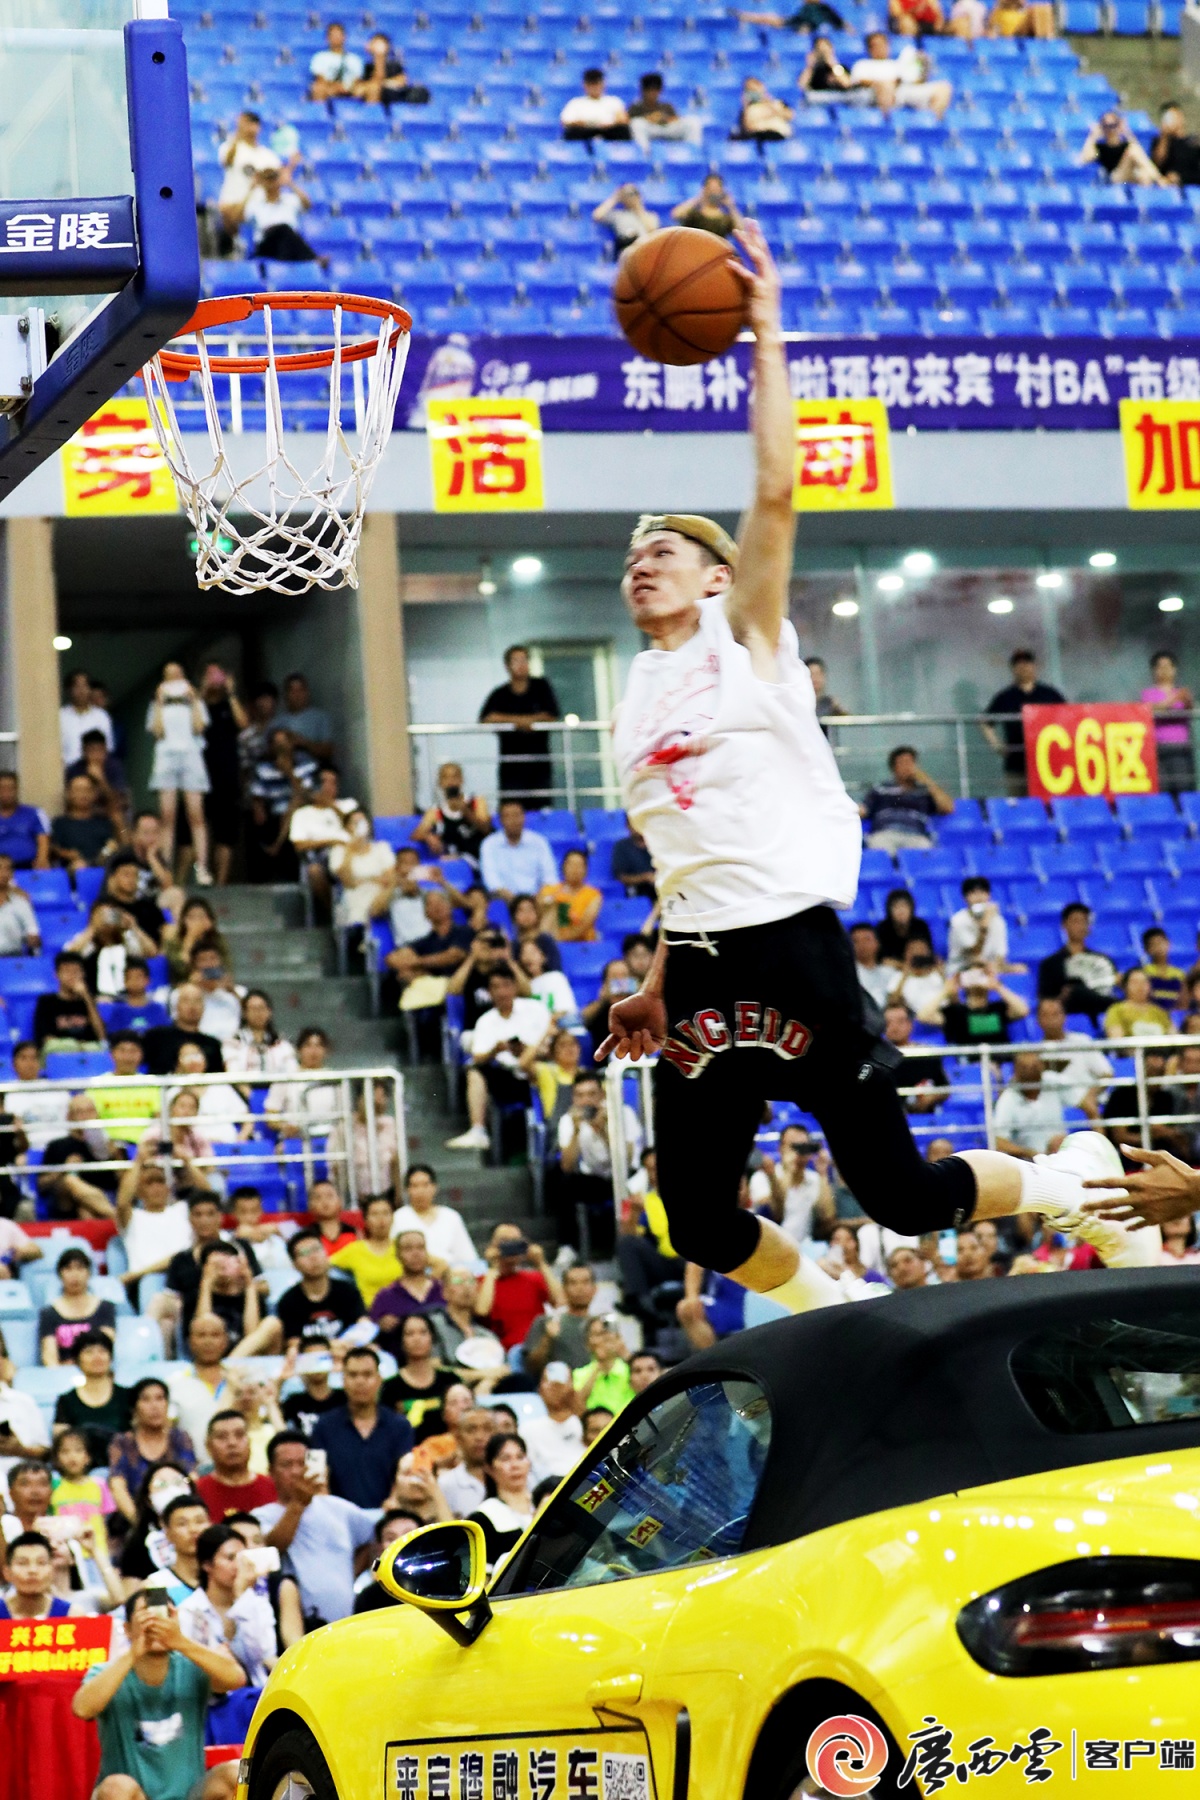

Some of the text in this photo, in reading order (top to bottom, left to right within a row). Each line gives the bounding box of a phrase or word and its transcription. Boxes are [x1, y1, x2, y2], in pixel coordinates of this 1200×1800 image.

[3, 211, 120, 252] 金陵
[621, 352, 1200, 411] 东鹏补啦预祝来宾“村BA”市级
[444, 413, 527, 496] 活
[797, 411, 879, 494] 动
[1135, 413, 1200, 495] 加
[1036, 717, 1152, 797] C6区
